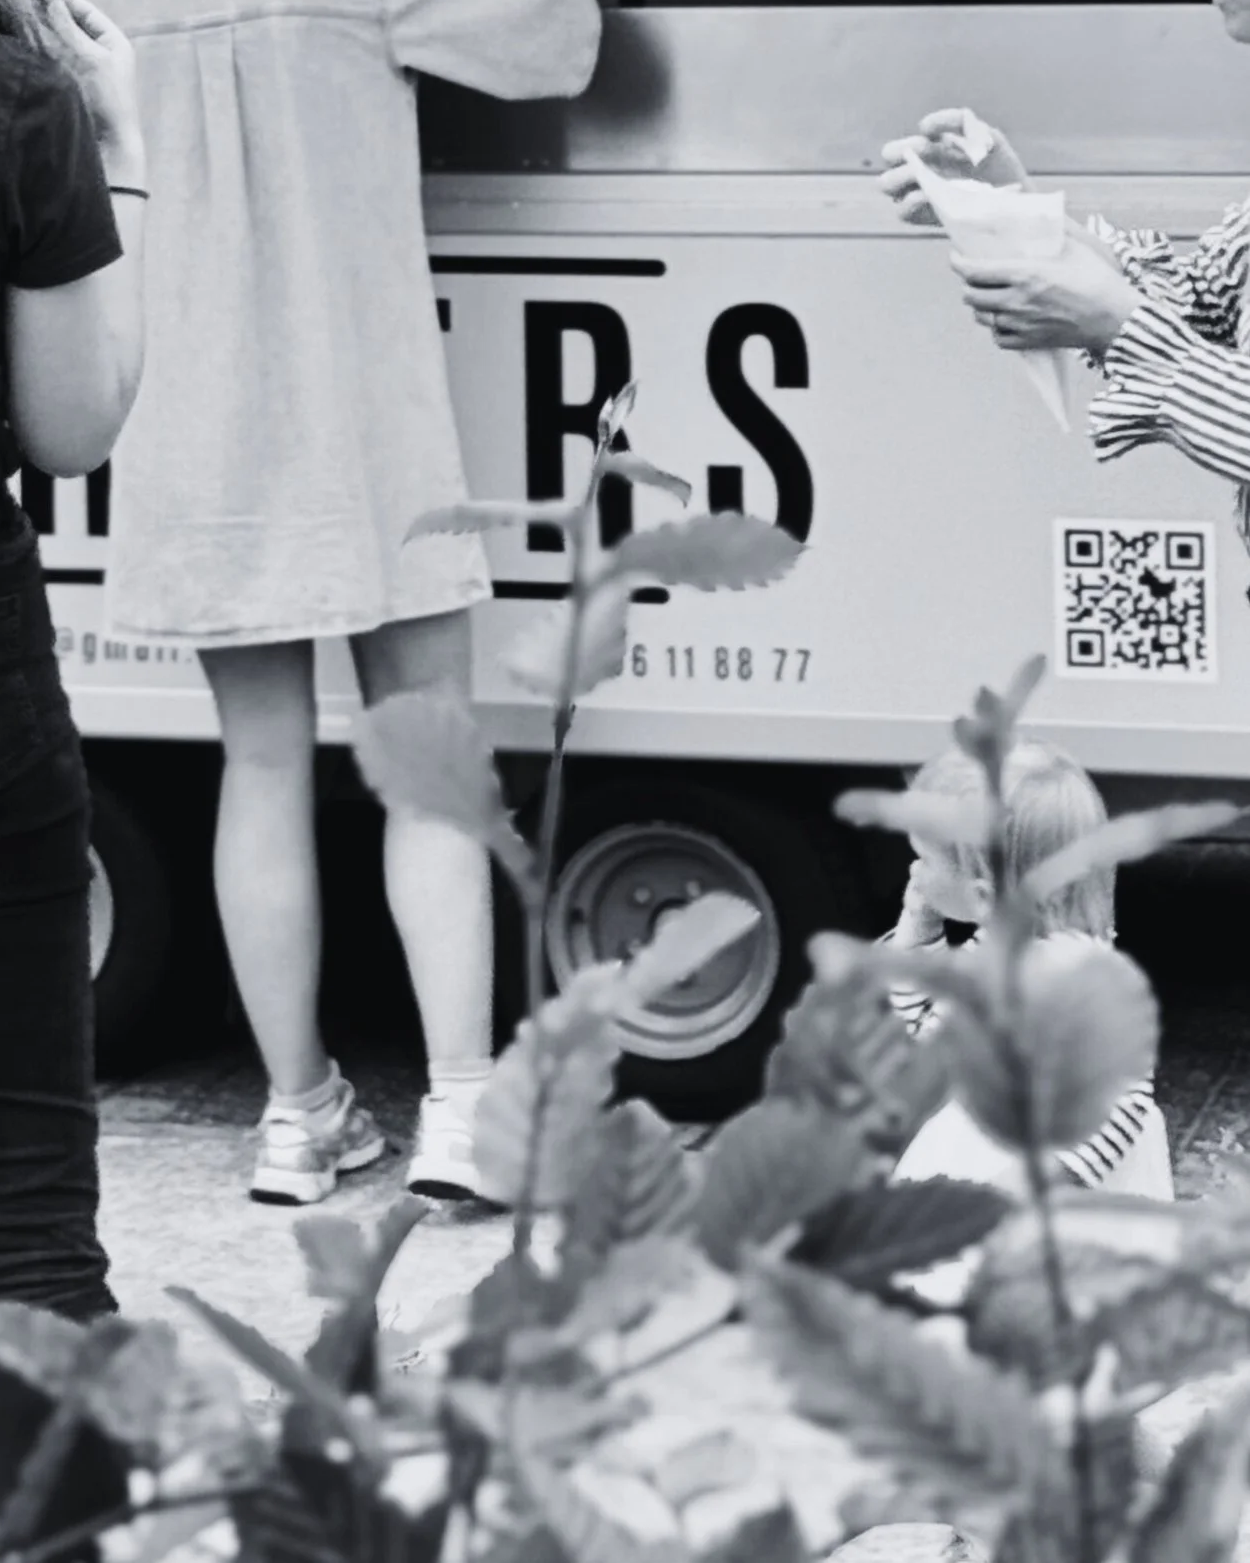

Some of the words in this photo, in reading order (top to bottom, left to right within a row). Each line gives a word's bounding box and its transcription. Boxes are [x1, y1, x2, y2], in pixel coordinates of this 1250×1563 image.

[667, 646, 694, 678] 11
[715, 646, 753, 681] 88
[772, 648, 811, 682] 77
